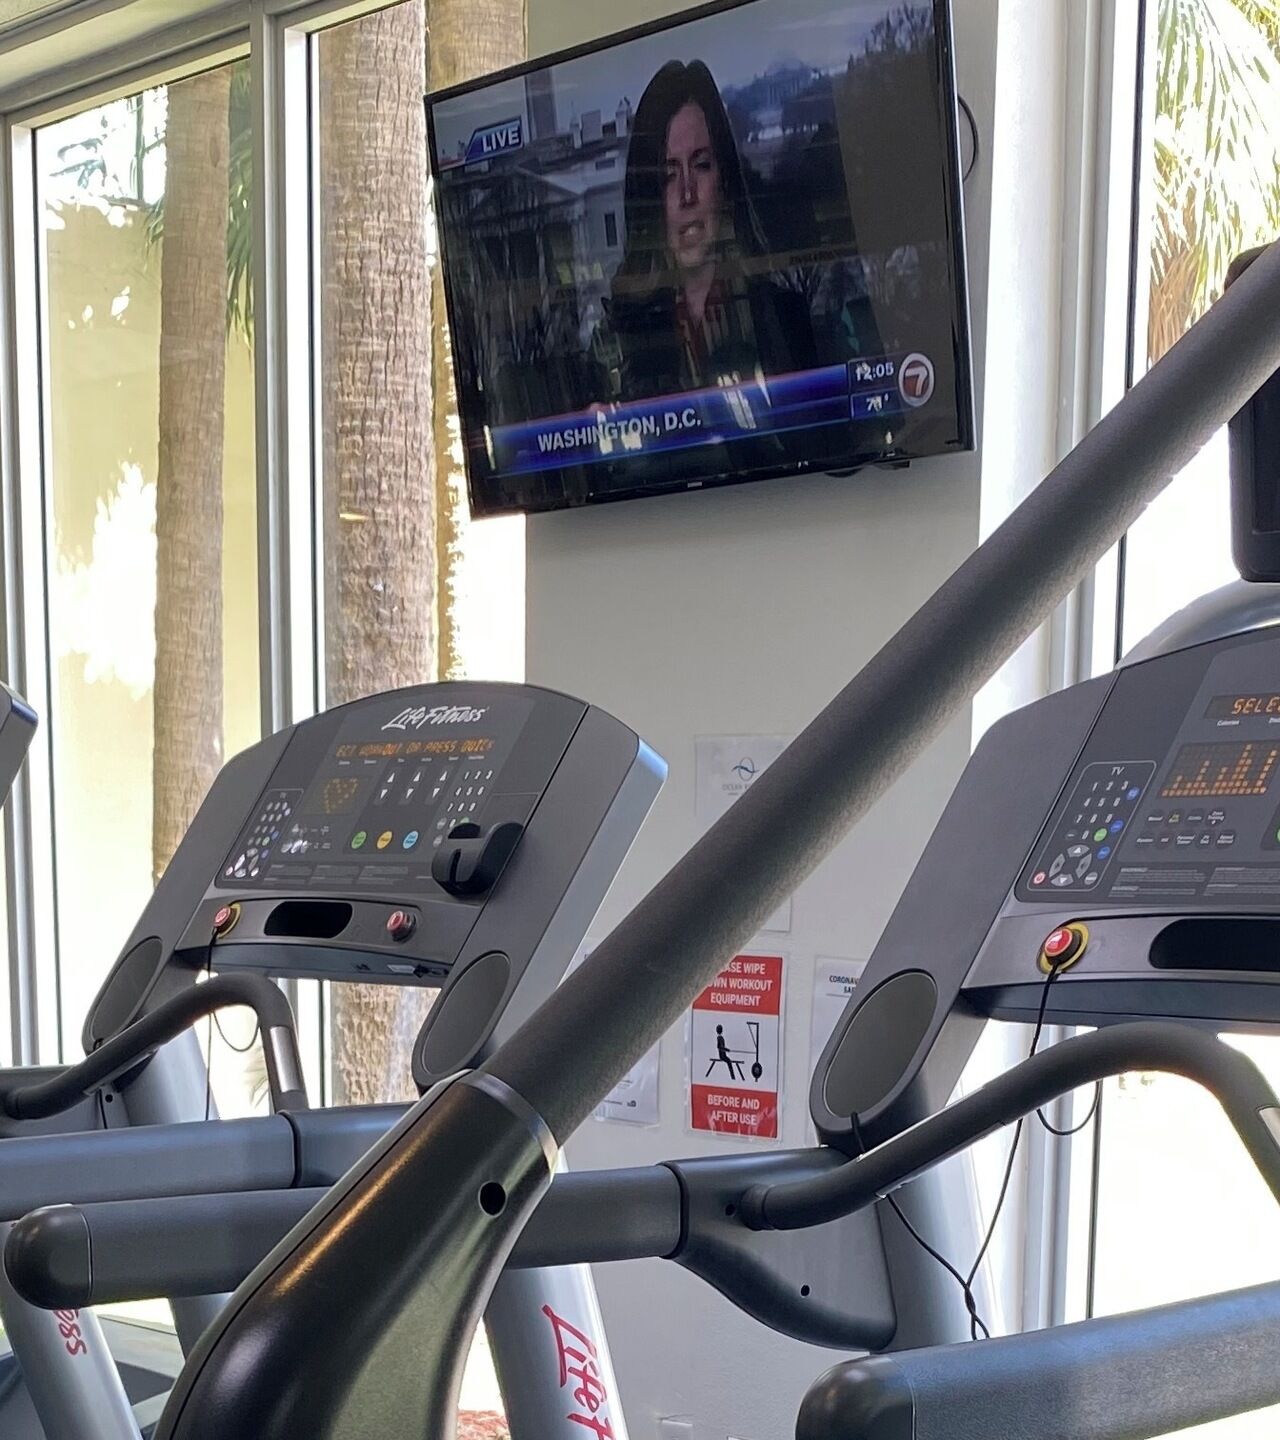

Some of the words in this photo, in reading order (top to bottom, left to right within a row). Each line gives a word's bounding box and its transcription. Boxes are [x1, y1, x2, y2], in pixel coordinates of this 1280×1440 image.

[482, 126, 520, 153] LIVE
[537, 415, 660, 453] WASHINGTON,
[664, 407, 702, 432] D.C.
[1111, 766, 1125, 776] TV
[743, 962, 766, 975] WIPE
[728, 977, 773, 992] WORKOUT
[710, 992, 762, 1007] EQUIPMENT
[707, 1094, 740, 1108] BEFORE
[741, 1097, 760, 1110] AND
[710, 1110, 738, 1124] AFTER
[740, 1113, 758, 1126] USE
